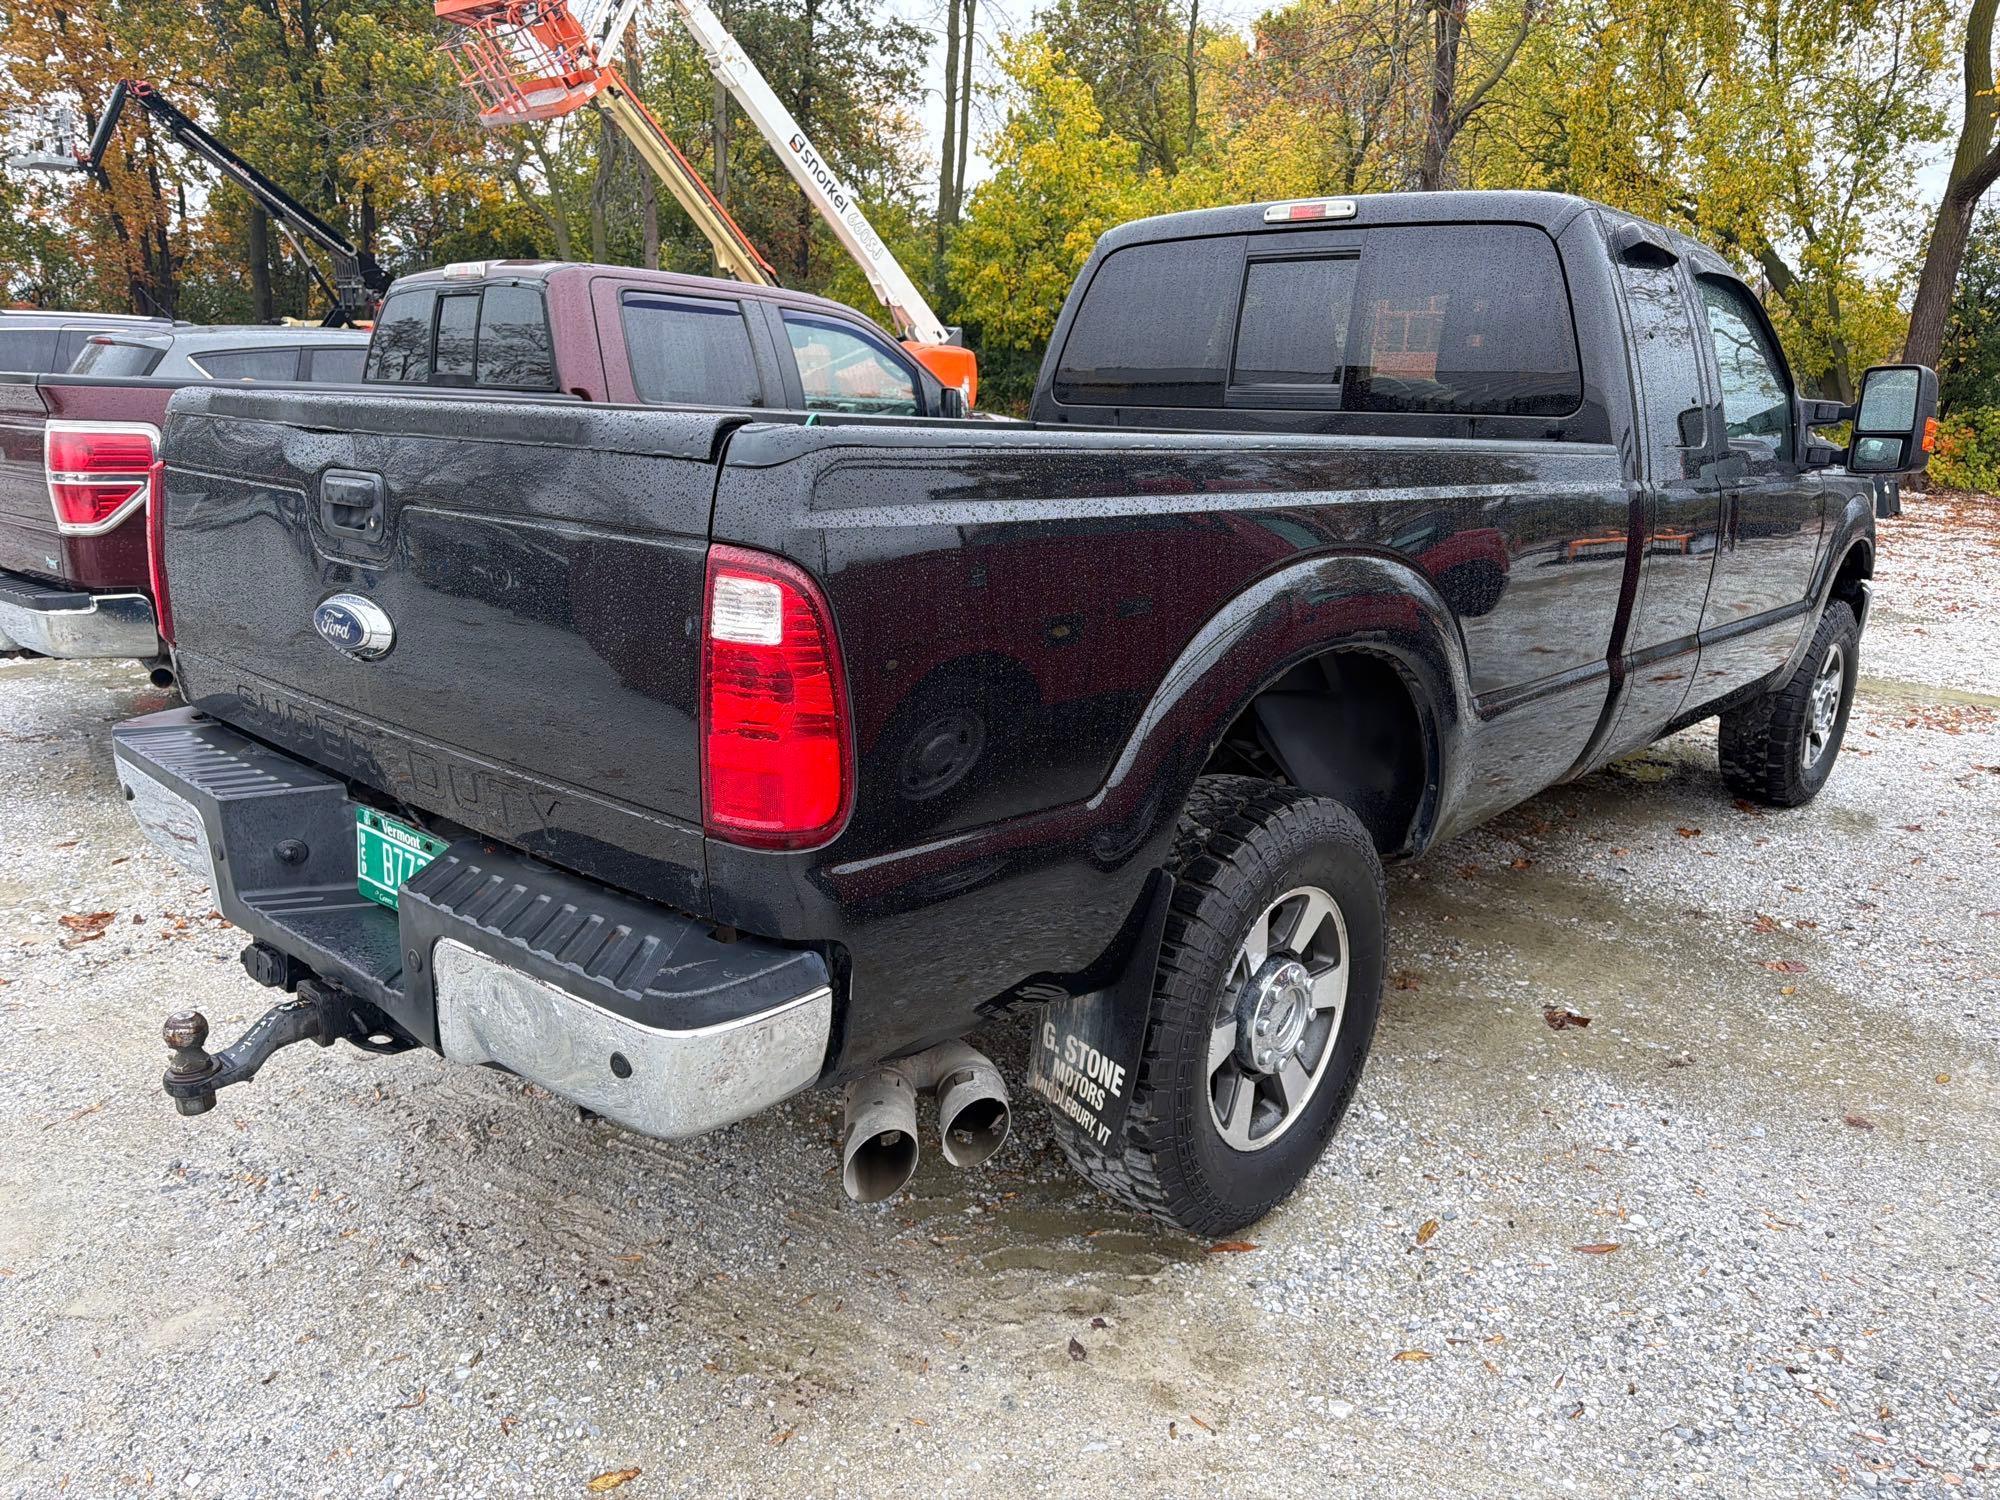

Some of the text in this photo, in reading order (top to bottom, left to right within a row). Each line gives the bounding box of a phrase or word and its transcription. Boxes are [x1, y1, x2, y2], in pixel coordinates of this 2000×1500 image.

[801, 150, 849, 214] snorkel
[321, 609, 351, 640] Ford
[407, 749, 563, 844] DUTY
[381, 819, 421, 849] Vermont
[382, 842, 428, 887] B77
[1043, 1022, 1126, 1098] G. STONE
[1052, 1057, 1106, 1111] MOTORS
[1034, 1072, 1112, 1146] MIDDLEBURY, VT
